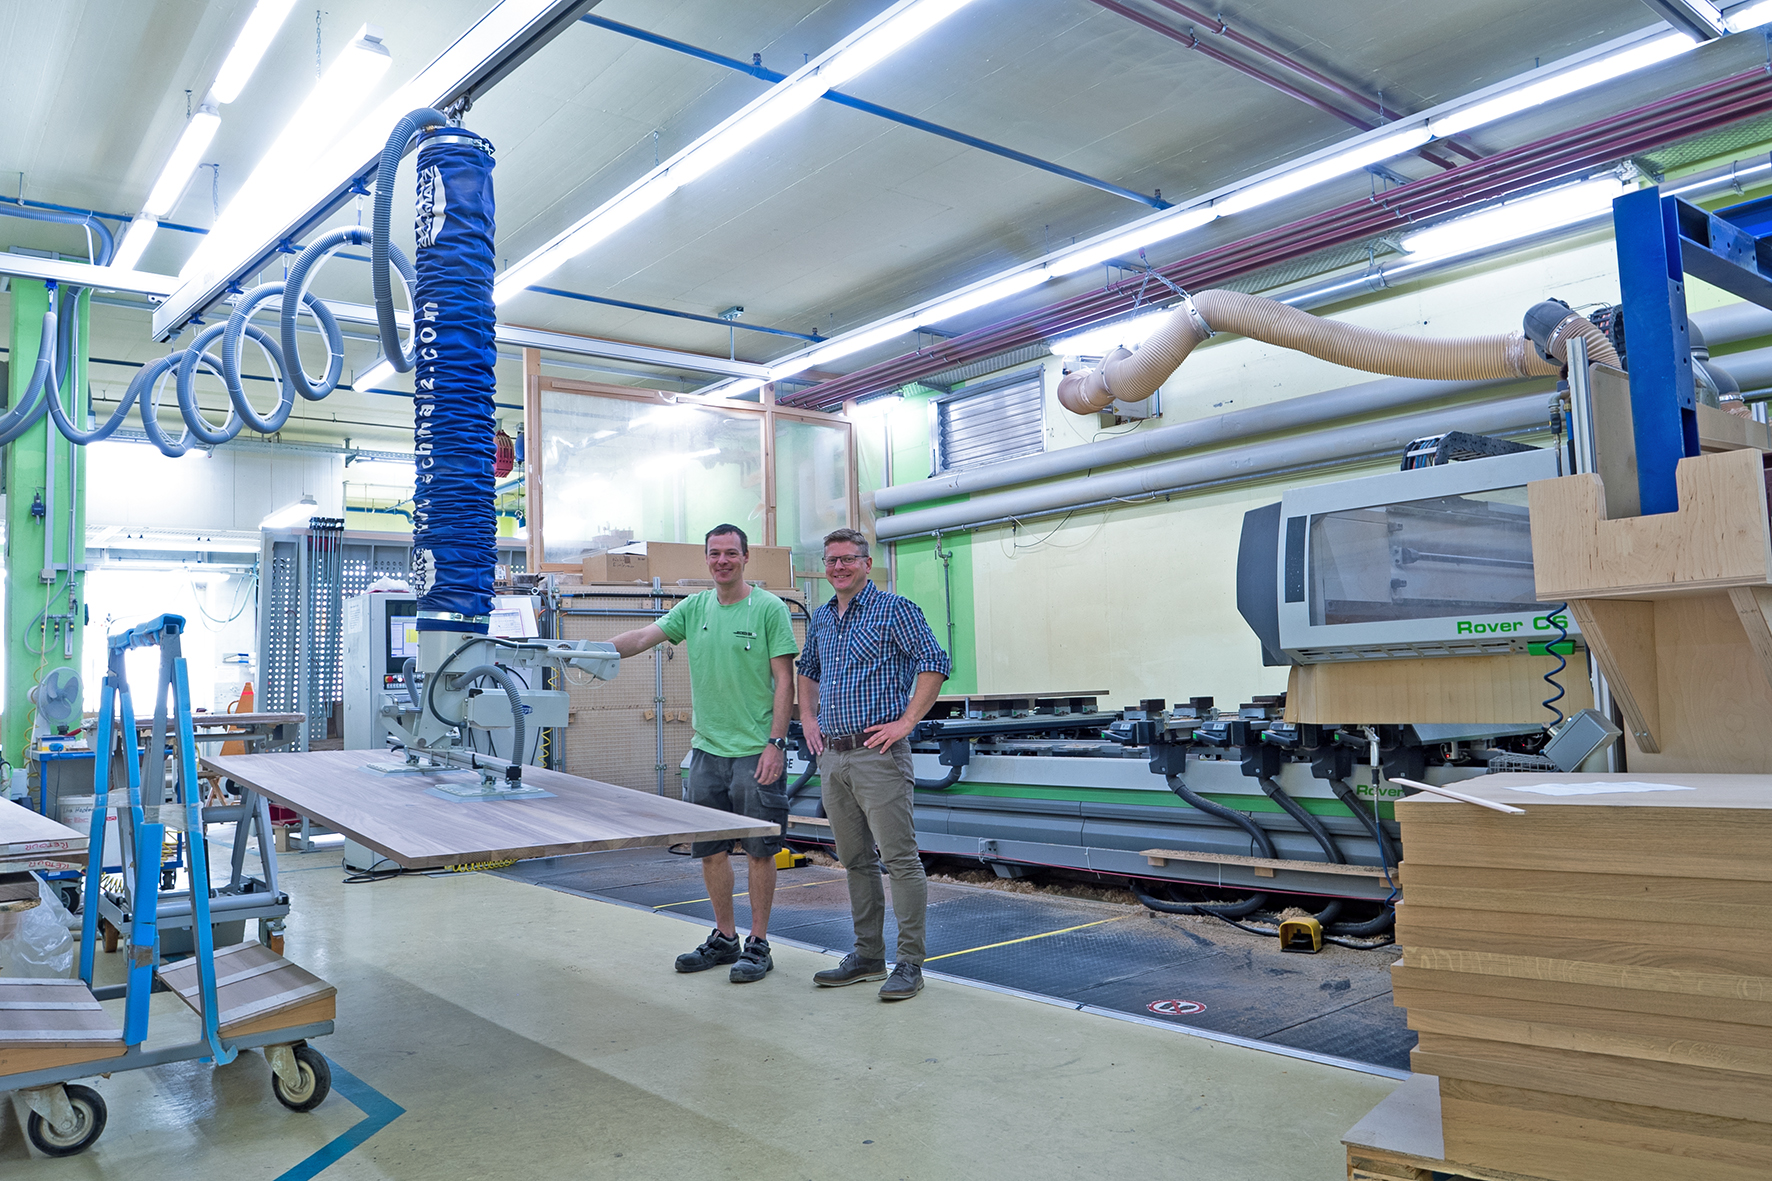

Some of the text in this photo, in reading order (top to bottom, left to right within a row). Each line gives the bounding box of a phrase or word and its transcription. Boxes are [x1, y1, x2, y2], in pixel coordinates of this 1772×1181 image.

[1457, 621, 1523, 634] Rover
[25, 841, 69, 851] RETOUR
[28, 860, 70, 869] RETOUR
